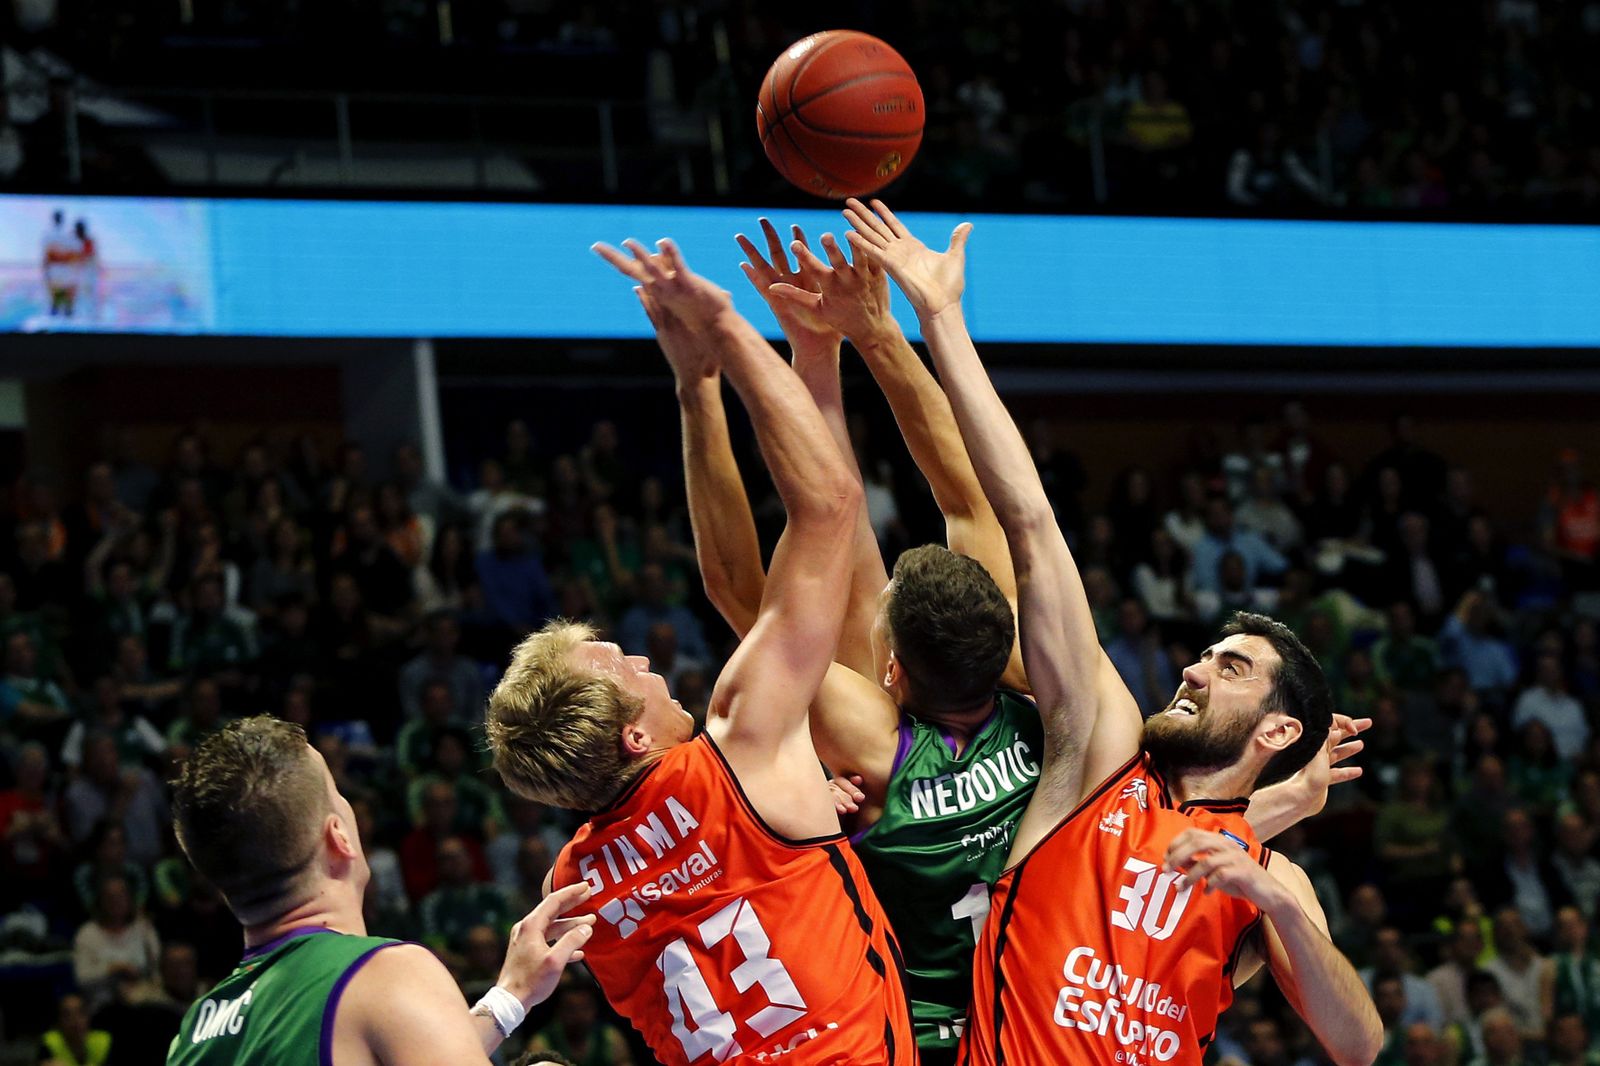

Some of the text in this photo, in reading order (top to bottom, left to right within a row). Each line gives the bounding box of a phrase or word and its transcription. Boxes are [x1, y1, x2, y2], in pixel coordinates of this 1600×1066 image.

[687, 868, 723, 896] pinturas
[1111, 857, 1194, 941] 30
[656, 897, 808, 1064] 43
[1156, 996, 1187, 1022] del
